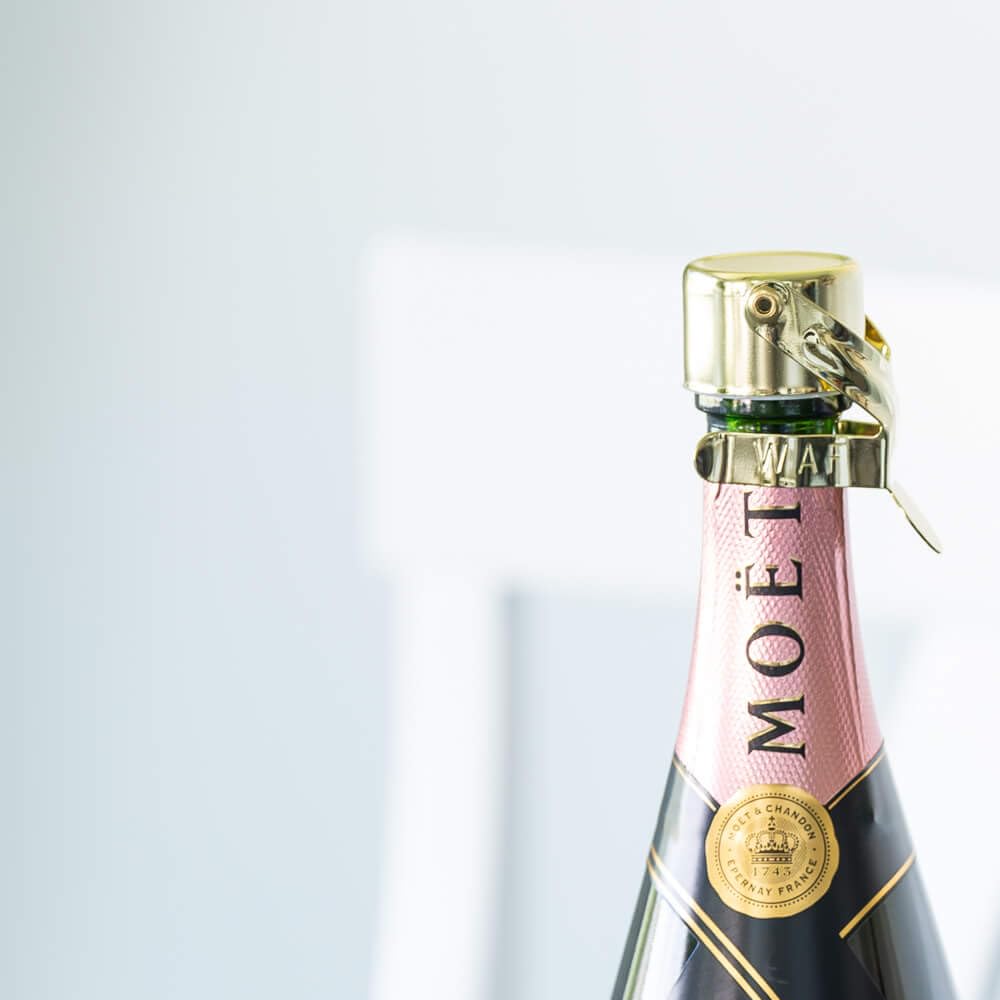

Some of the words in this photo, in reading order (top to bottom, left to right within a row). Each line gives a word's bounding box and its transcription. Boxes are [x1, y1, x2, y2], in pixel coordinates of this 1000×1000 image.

[735, 491, 805, 758] MOËT
[766, 804, 817, 840] CHANDON
[778, 859, 818, 896] FRANCE
